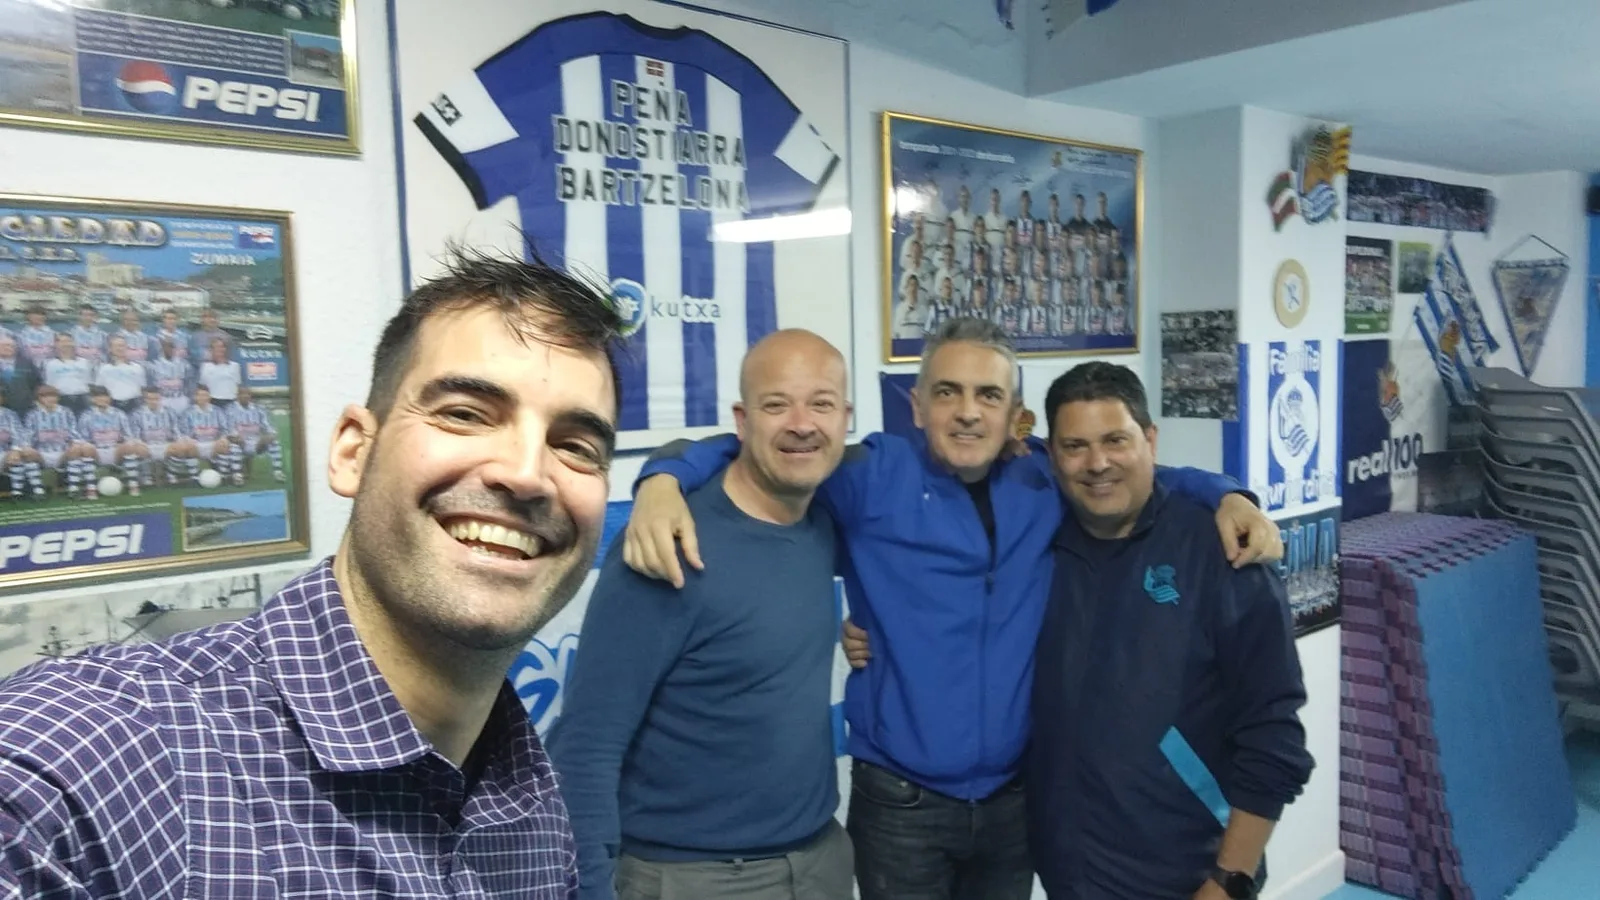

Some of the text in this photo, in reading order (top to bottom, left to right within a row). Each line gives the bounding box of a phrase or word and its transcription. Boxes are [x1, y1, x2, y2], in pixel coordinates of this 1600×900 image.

[183, 76, 320, 122] PEPSI
[611, 80, 692, 127] PEÑA
[552, 114, 748, 170] DONOSTIARRA
[555, 163, 751, 213] BARTZELONA
[650, 295, 721, 318] kutxa
[0, 524, 144, 568] PEPSI
